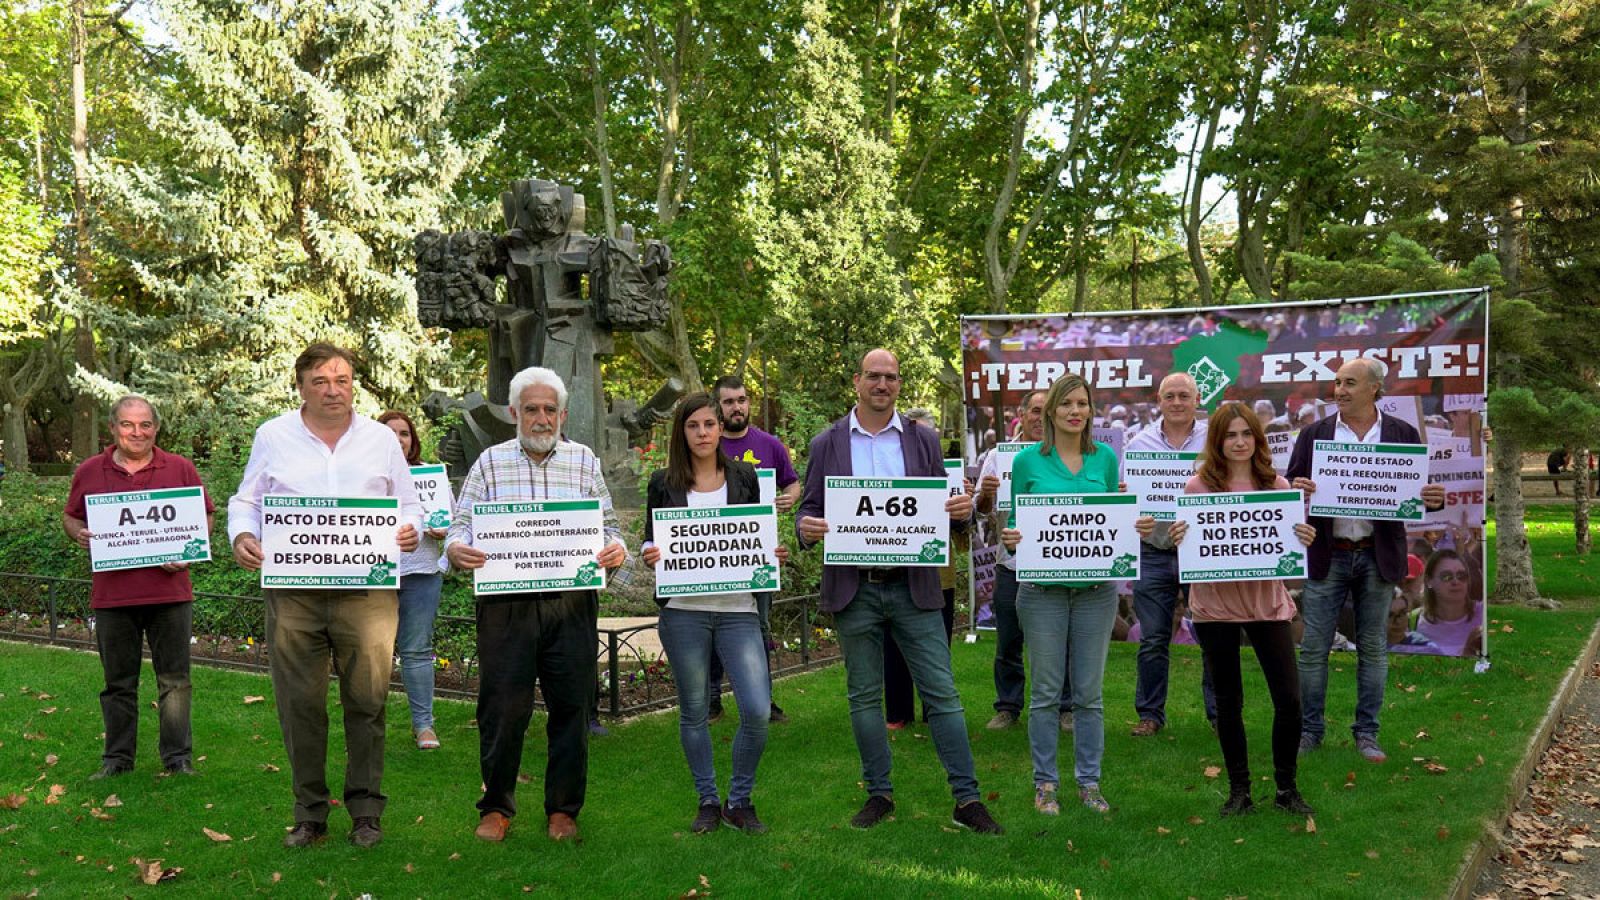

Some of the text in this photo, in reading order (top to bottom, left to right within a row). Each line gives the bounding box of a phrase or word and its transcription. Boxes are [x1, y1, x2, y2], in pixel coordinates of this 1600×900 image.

[971, 359, 1153, 399] ¡TERUEL
[1348, 444, 1376, 452] EXISTE
[1328, 456, 1413, 466] PACTO DE ESTADO
[1319, 468, 1338, 476] POR
[1353, 470, 1420, 480] REEQUILIBRIO
[414, 480, 437, 490] NIO
[863, 480, 892, 488] EXISTE
[1348, 482, 1396, 492] COHESIÓN
[89, 494, 151, 505] TERUEL EXISTE
[428, 492, 435, 500] Y
[1020, 497, 1083, 505] TERUEL EXISTE
[1146, 494, 1176, 502] GENER
[1180, 496, 1244, 505] TERUEL EXISTE
[1337, 496, 1398, 506] TERRITORIAL
[266, 498, 338, 507] TERUEL EXISTE
[856, 496, 918, 516] A-68
[476, 504, 544, 514] TERUEL EXISTE
[1312, 507, 1358, 516] AGRUPACIÓN
[118, 504, 176, 526] A-40
[265, 513, 397, 526] PACTO DE ESTADO
[657, 510, 720, 520] TERUEL EXISTE
[1049, 513, 1106, 526] CAMPO
[1197, 509, 1283, 524] SER POCOS
[516, 519, 561, 528] CORREDOR
[837, 525, 888, 534] ZARAGOZA
[896, 524, 936, 534] ALCAÑIZ
[94, 532, 124, 540] CUENCA
[130, 529, 158, 537] TERUEL
[164, 526, 199, 534] UTRILLAS
[477, 528, 599, 540] CANTÁBRICO-MEDITERRÁNEO
[670, 521, 760, 538] SEGURIDAD
[1203, 526, 1279, 540] NO RESTA
[107, 538, 140, 548] ALCAÑIZ
[146, 534, 192, 544] TARRAGONA
[290, 534, 372, 545] CONTRA LA
[1037, 529, 1118, 543] JUSTICIA Y
[669, 538, 762, 554] CIUDADANA
[865, 538, 907, 546] VINAROZ
[485, 549, 593, 561] DOBLE VÍA ELECTRIFICADA
[1042, 545, 1113, 559] EQUIDAD
[1200, 542, 1284, 557] DERECHOS
[96, 555, 183, 569] AGRUPACIÓN ELECTORES
[274, 552, 388, 565] DESPOBLACIÓN
[664, 554, 770, 571] MEDIO RURAL
[828, 553, 876, 561] AGRUPACIÓN
[1020, 569, 1068, 578] AGRUPACIÓN
[1184, 568, 1276, 579] AGRUPACIÓN ELECTORES
[266, 576, 367, 585] AGRUPACIÓN ELECTORES
[479, 580, 575, 590] AGRUPACIÓN ELECTORES
[661, 584, 708, 594] AGRUPACIÓN
